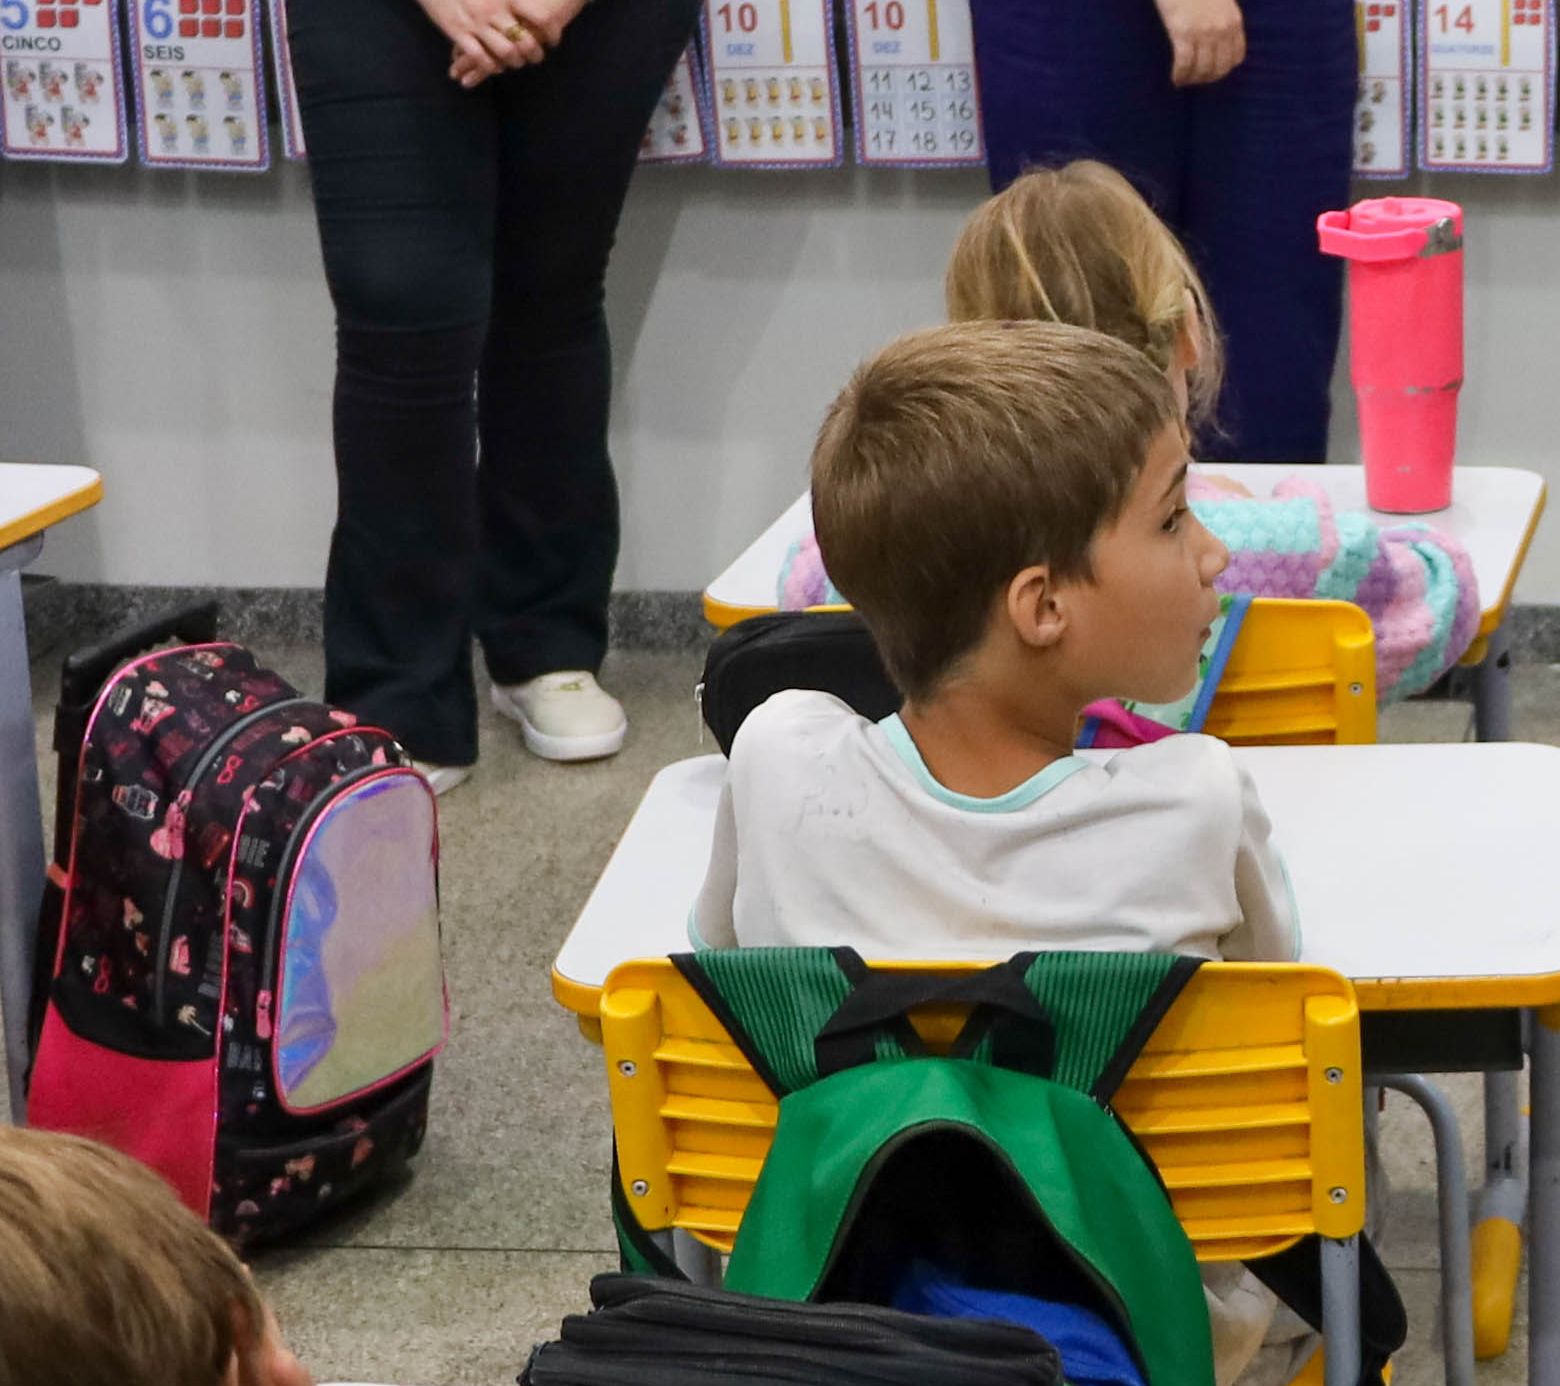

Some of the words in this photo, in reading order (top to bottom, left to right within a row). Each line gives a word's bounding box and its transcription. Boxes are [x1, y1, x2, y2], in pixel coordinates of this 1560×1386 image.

[716, 2, 759, 34] 10
[864, 0, 905, 31] 10
[1432, 4, 1476, 34] 14
[2, 34, 61, 52] CINCO
[143, 44, 185, 62] SEIS
